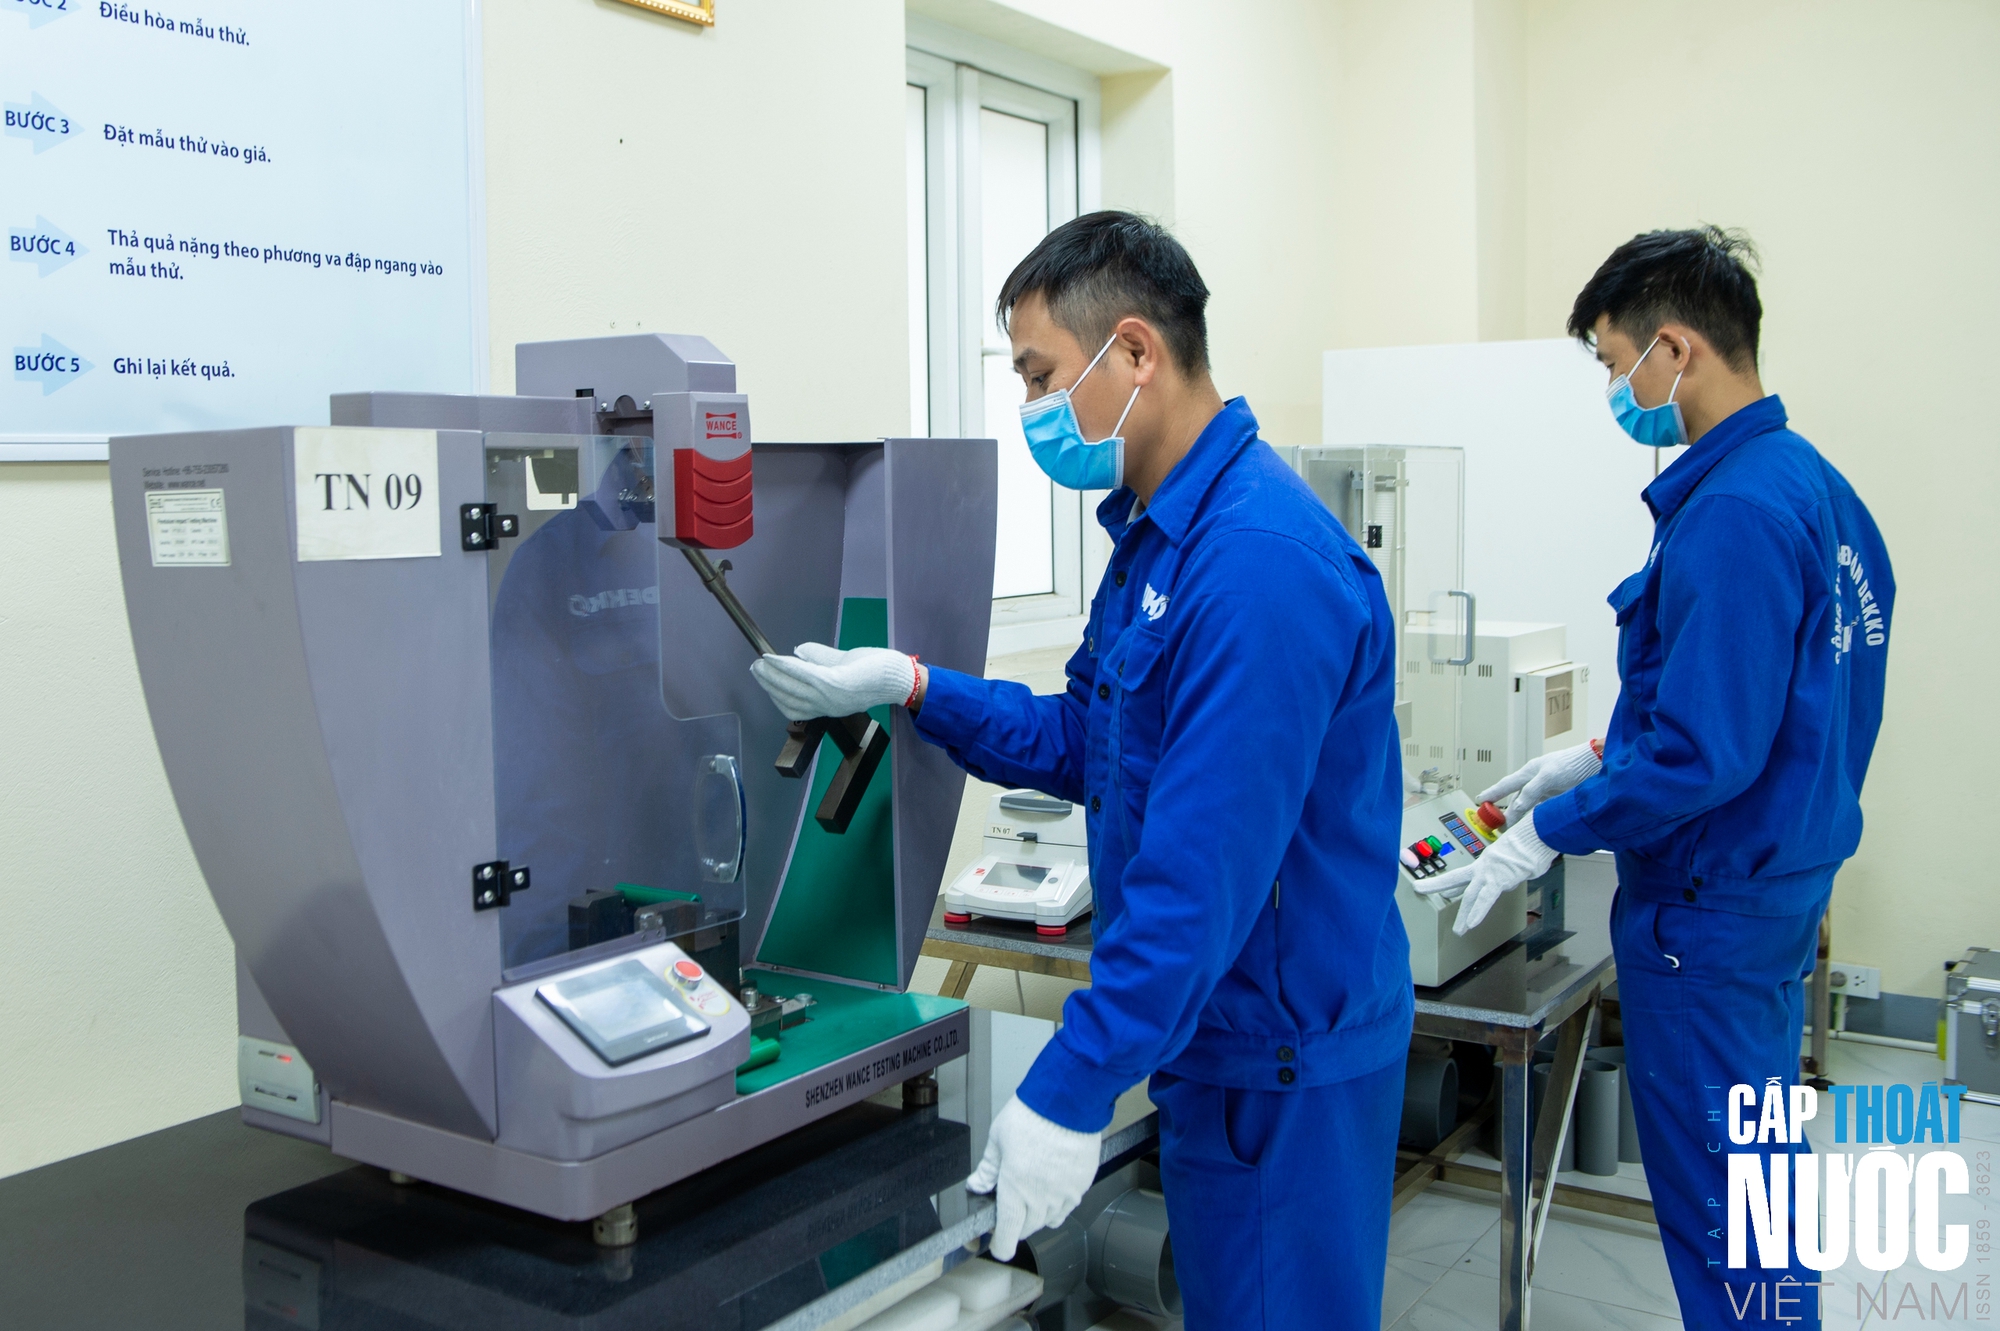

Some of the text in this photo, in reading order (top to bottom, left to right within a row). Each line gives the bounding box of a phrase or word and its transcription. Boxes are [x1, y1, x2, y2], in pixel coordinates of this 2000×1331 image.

[99, 1, 250, 46] Điều hòa mẫu thử.
[5, 110, 70, 134] BƯỚC 3
[103, 123, 272, 164] Đặt mẫu thử vào giá.
[10, 235, 76, 256] BƯỚC 4
[107, 229, 443, 277] Thả quả nặng theo phương va đập ngang vào
[109, 257, 184, 280] mẫu thử.
[15, 352, 80, 372] BƯỚC 5
[113, 357, 236, 381] Ghi lại kết quả.
[706, 420, 737, 431] WANCE
[314, 473, 422, 510] TN 09
[1857, 578, 1885, 646] DEKKO
[991, 826, 1001, 834] TN
[805, 1075, 844, 1109] SHENZHEN
[845, 1064, 871, 1090] WANCE
[872, 1053, 901, 1080] TESTING
[902, 1040, 931, 1067] MACHINE
